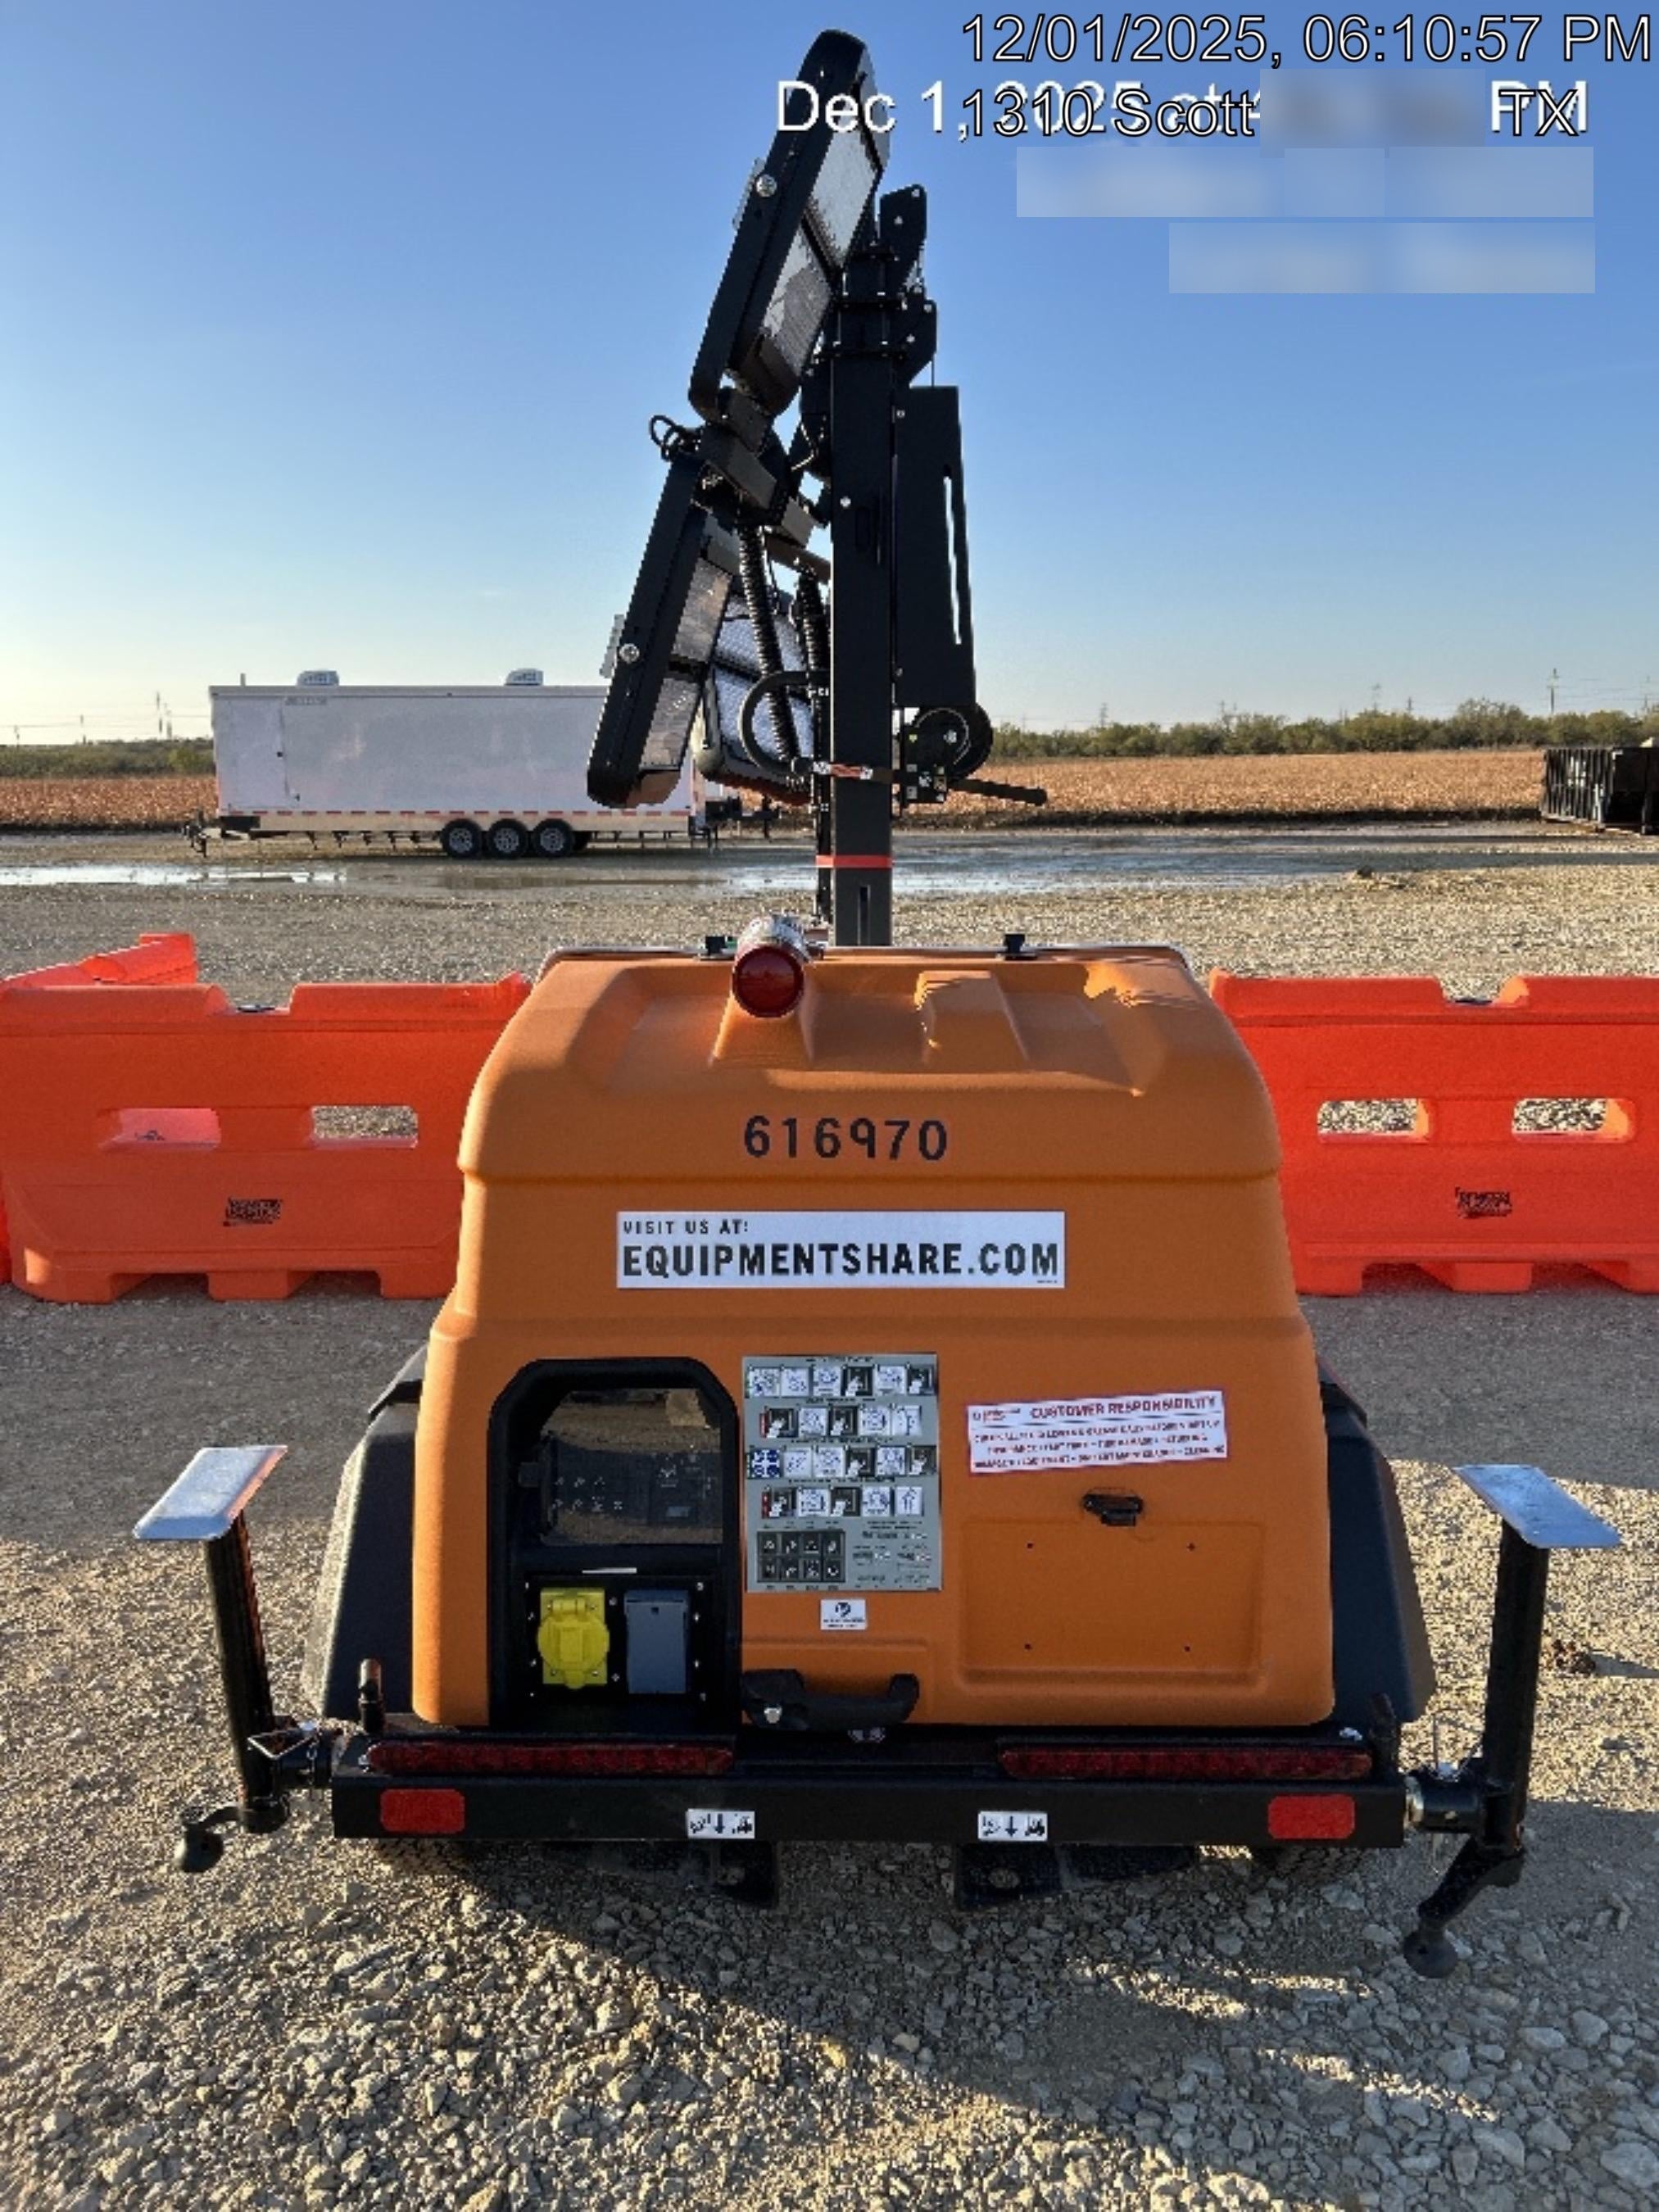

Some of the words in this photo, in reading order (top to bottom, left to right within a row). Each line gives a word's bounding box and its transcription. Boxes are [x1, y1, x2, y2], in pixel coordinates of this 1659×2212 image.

[744, 1115, 948, 1161] 616970
[623, 1221, 675, 1235] VISIT
[685, 1219, 709, 1235] US
[719, 1219, 749, 1235] AT:
[623, 1242, 1058, 1279] EQUIPMENTSHARE.COM
[1030, 1403, 1105, 1419] CUSTOMER
[1108, 1396, 1216, 1415] RESPONSIBILITY
